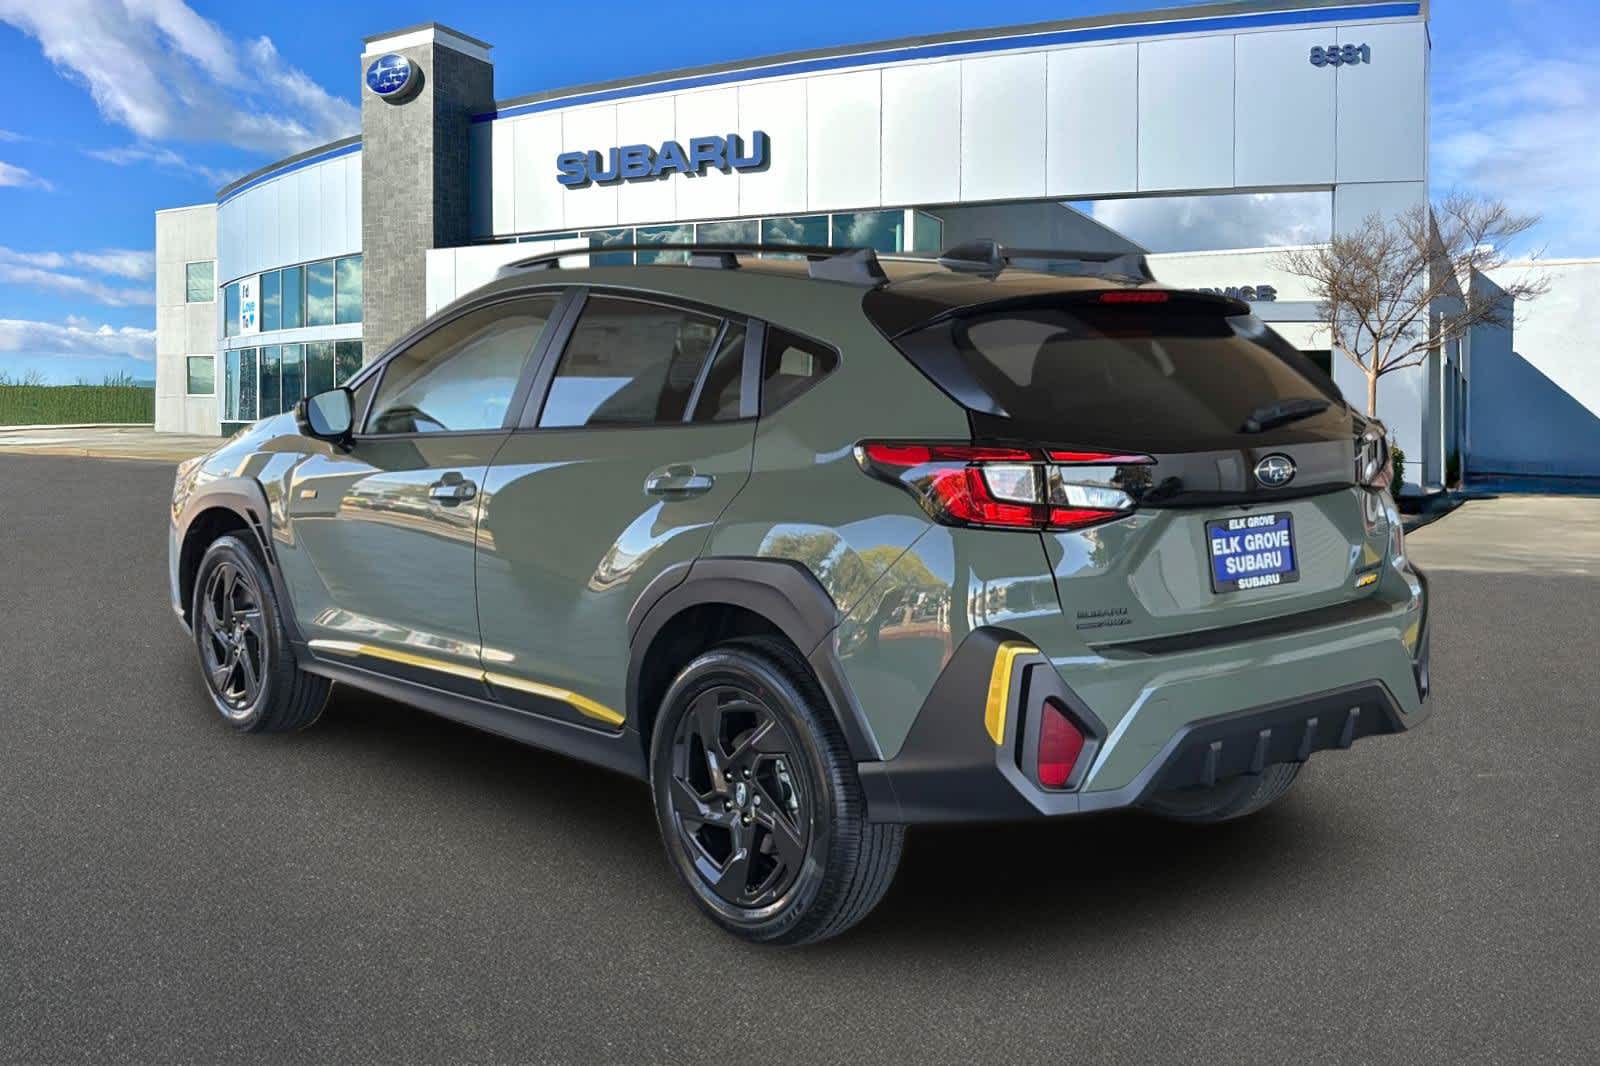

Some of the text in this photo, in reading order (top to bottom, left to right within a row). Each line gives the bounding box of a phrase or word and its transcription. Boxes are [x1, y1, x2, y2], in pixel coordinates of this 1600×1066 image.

[556, 130, 771, 190] SUBARU
[1188, 285, 1278, 301] VICE
[1228, 515, 1276, 530] ELK GROVE
[1212, 530, 1290, 556] ELK GROVE
[1225, 551, 1282, 574] SUBARU
[1238, 573, 1281, 589] SUBARU
